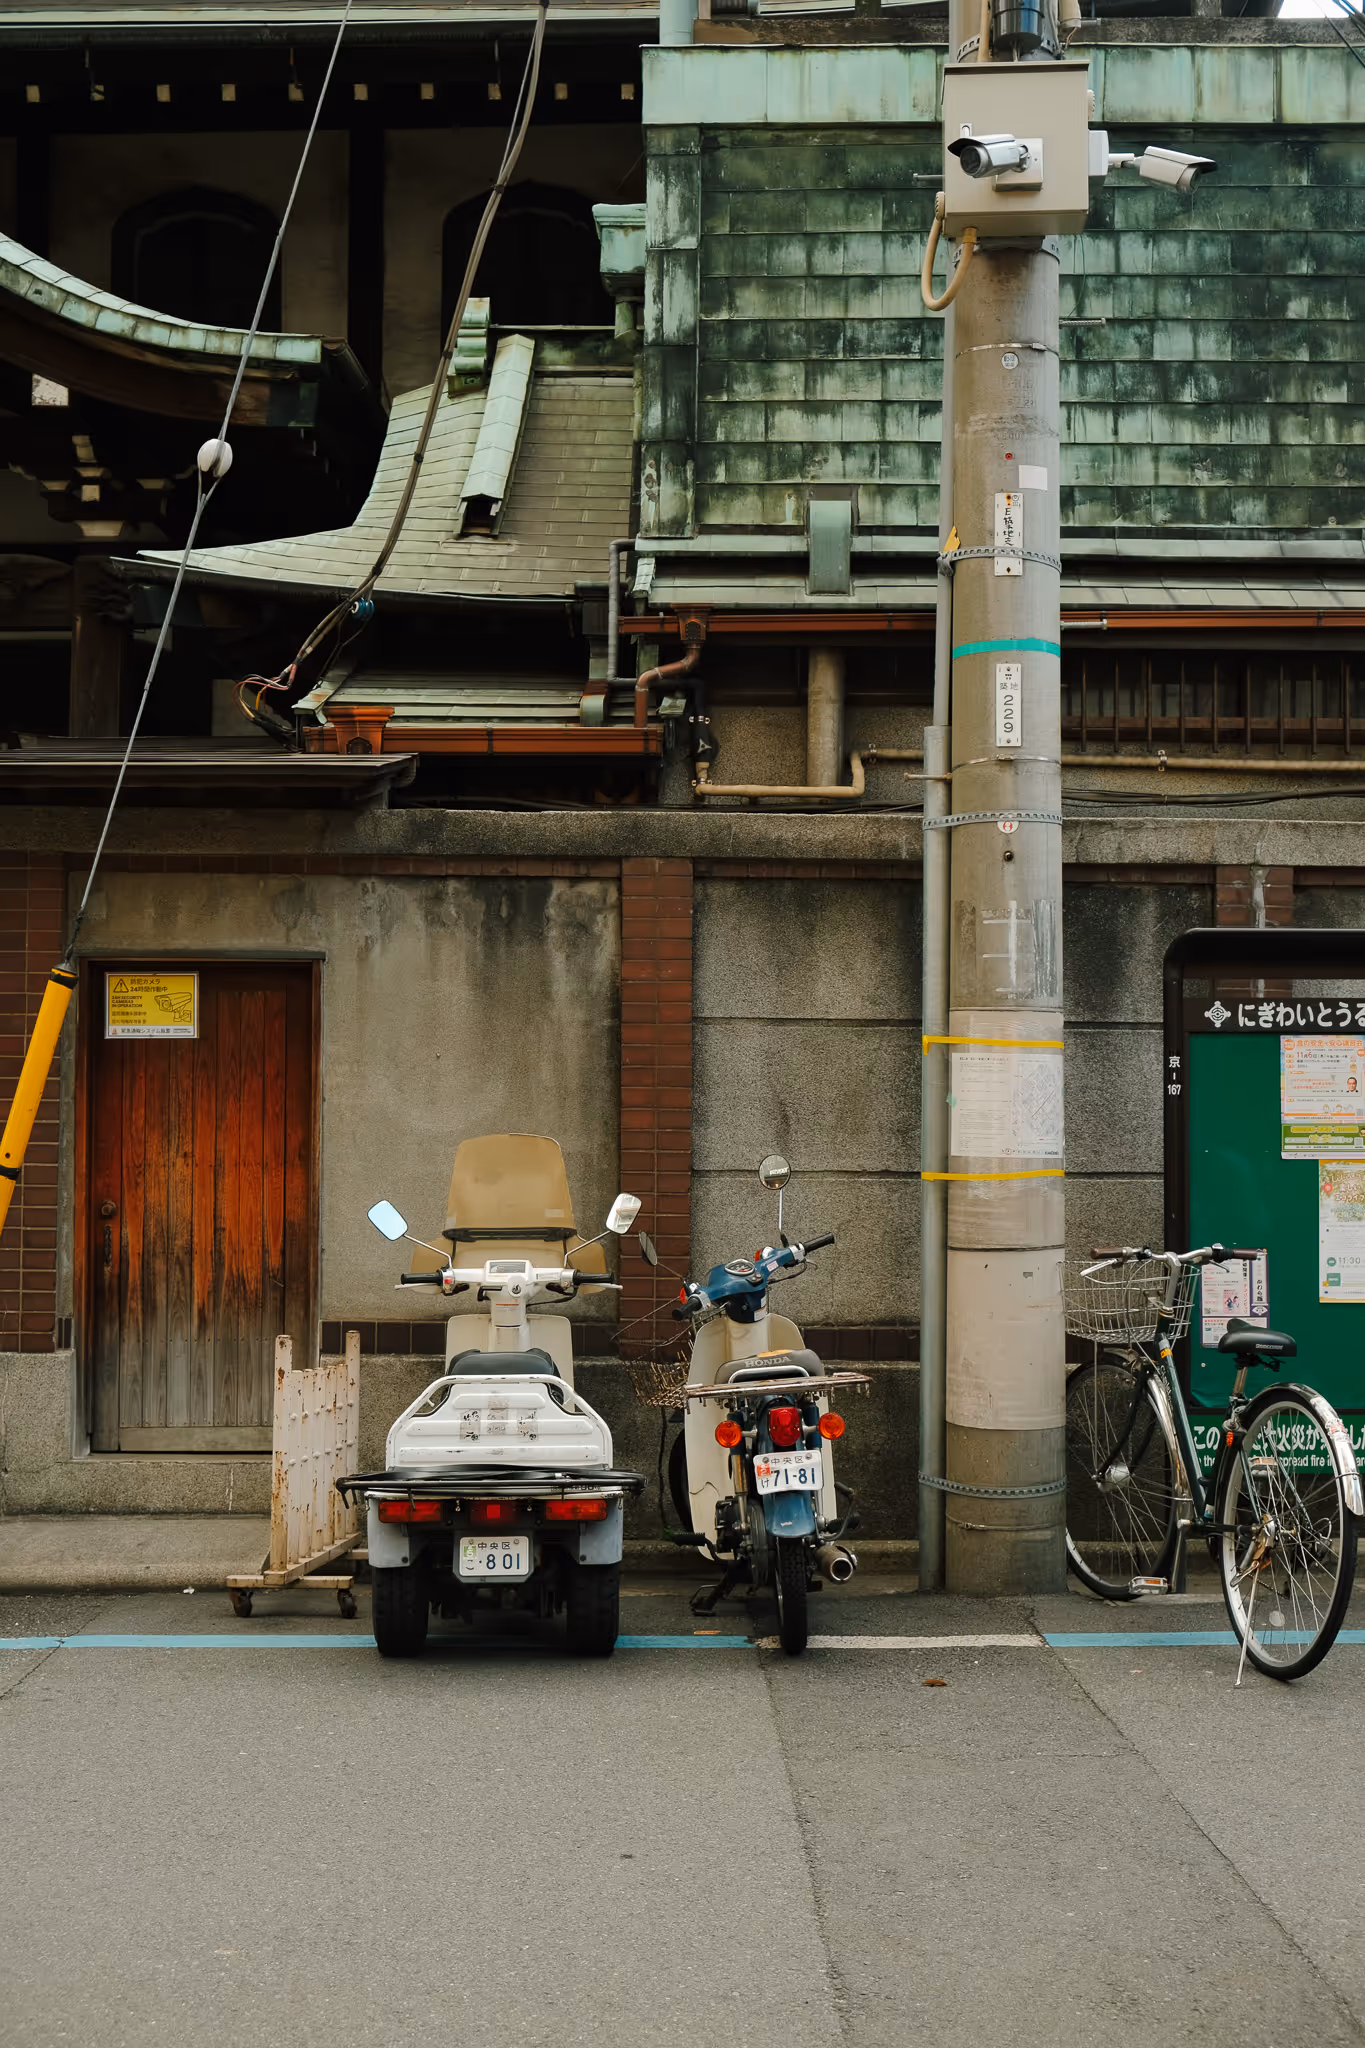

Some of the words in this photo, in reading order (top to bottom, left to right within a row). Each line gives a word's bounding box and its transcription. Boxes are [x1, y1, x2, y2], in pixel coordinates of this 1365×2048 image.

[1003, 694, 1014, 733] 229
[1338, 1257, 1361, 1265] 11:30
[744, 1356, 793, 1368] HONDA
[771, 1455, 804, 1465] 中央区
[1310, 1454, 1325, 1467] fire
[761, 1477, 770, 1489] け
[771, 1467, 816, 1487] 71-81
[477, 1541, 511, 1550] 中央区
